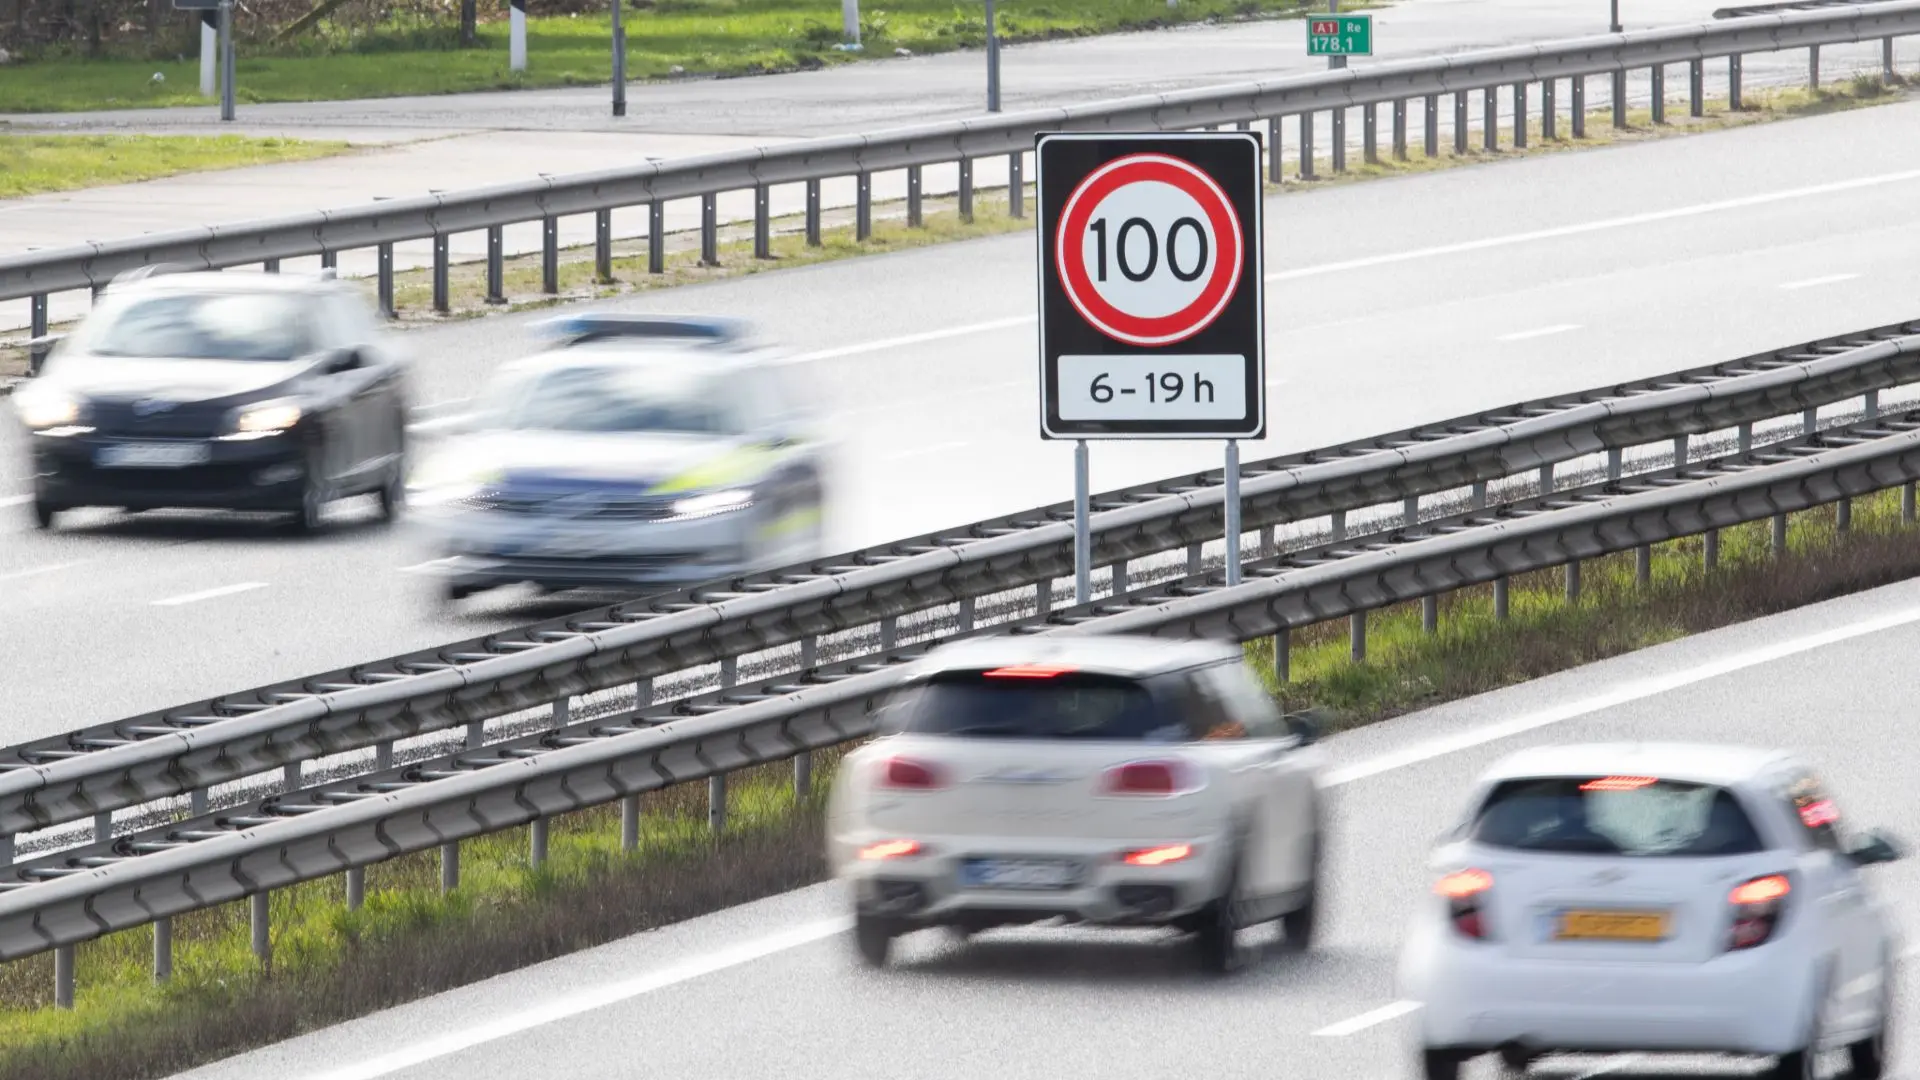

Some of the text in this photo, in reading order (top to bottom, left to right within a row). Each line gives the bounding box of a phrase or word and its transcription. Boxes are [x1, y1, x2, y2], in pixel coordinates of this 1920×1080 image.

[1317, 22, 1362, 33] A1 Re
[1090, 216, 1208, 282] 100
[1193, 371, 1214, 403] h
